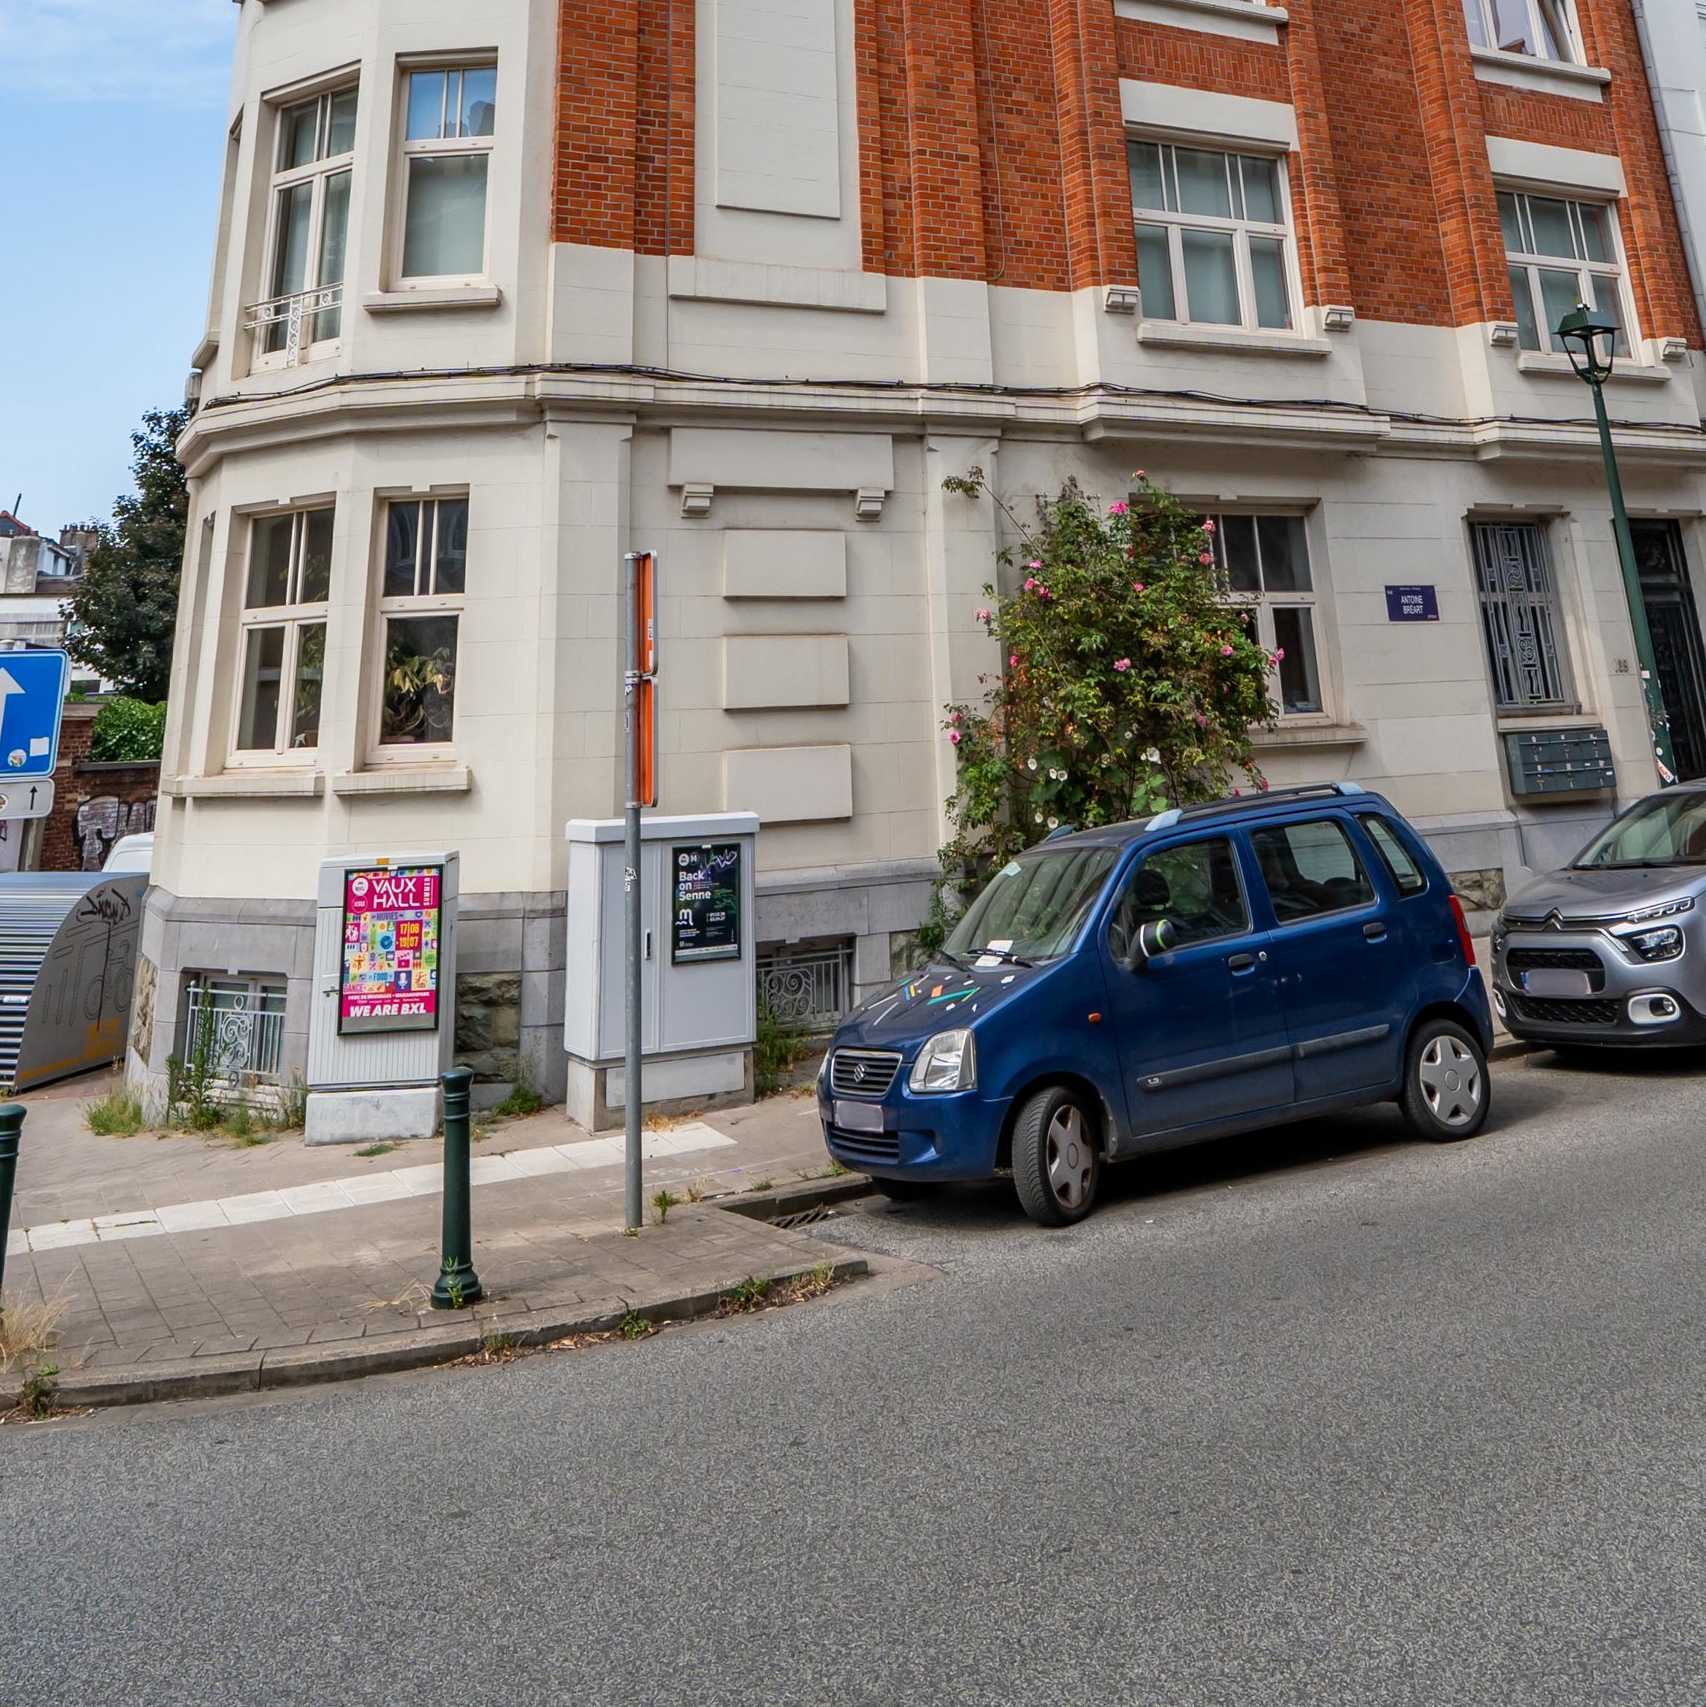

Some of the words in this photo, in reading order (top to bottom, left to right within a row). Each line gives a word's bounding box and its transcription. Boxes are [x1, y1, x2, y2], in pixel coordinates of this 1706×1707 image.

[1401, 595, 1423, 604] ANTOINE
[1403, 604, 1423, 614] BRÉART
[679, 870, 705, 881] Back
[372, 877, 417, 893] VAUX
[679, 882, 693, 891] on
[373, 893, 420, 909] HALL
[679, 890, 712, 902] Senne
[350, 1005, 371, 1018] WE
[372, 1003, 400, 1017] ARE
[400, 1002, 427, 1015] BXL
